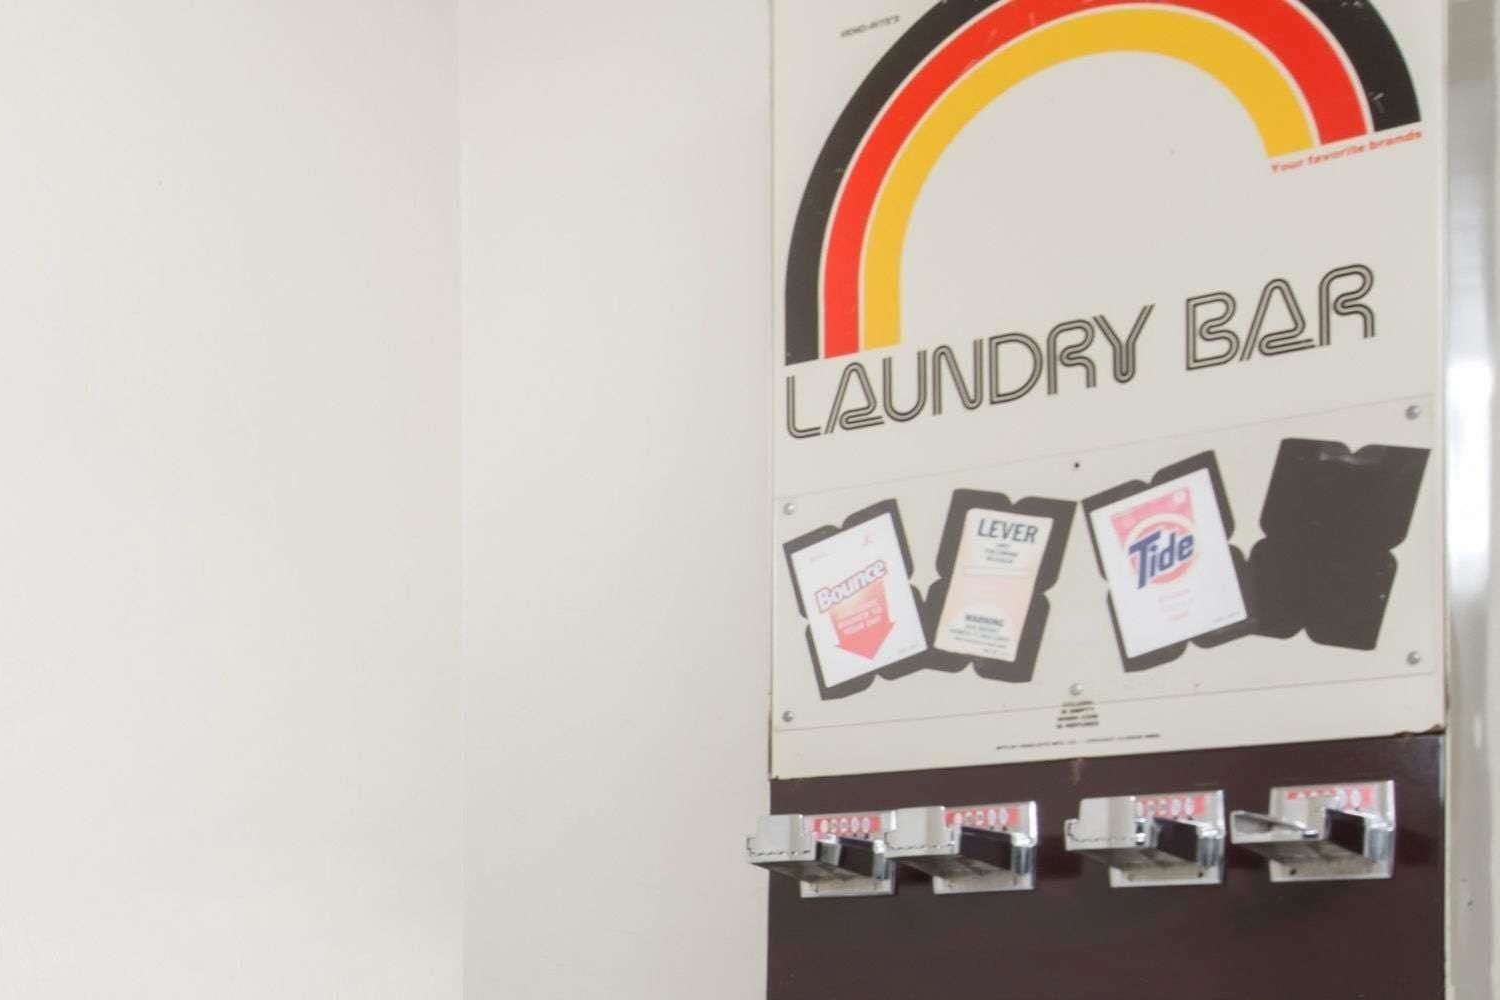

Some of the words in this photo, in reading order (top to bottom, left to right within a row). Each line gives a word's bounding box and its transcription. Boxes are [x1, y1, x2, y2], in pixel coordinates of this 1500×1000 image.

[1271, 159, 1303, 173] Your
[1308, 145, 1365, 164] favorite
[1369, 130, 1422, 149] brands
[786, 303, 1155, 438] LAUNDRY
[1185, 263, 1375, 370] BAR
[977, 518, 1038, 544] LEVER
[1128, 530, 1194, 589] Tide
[815, 560, 888, 613] Bounce
